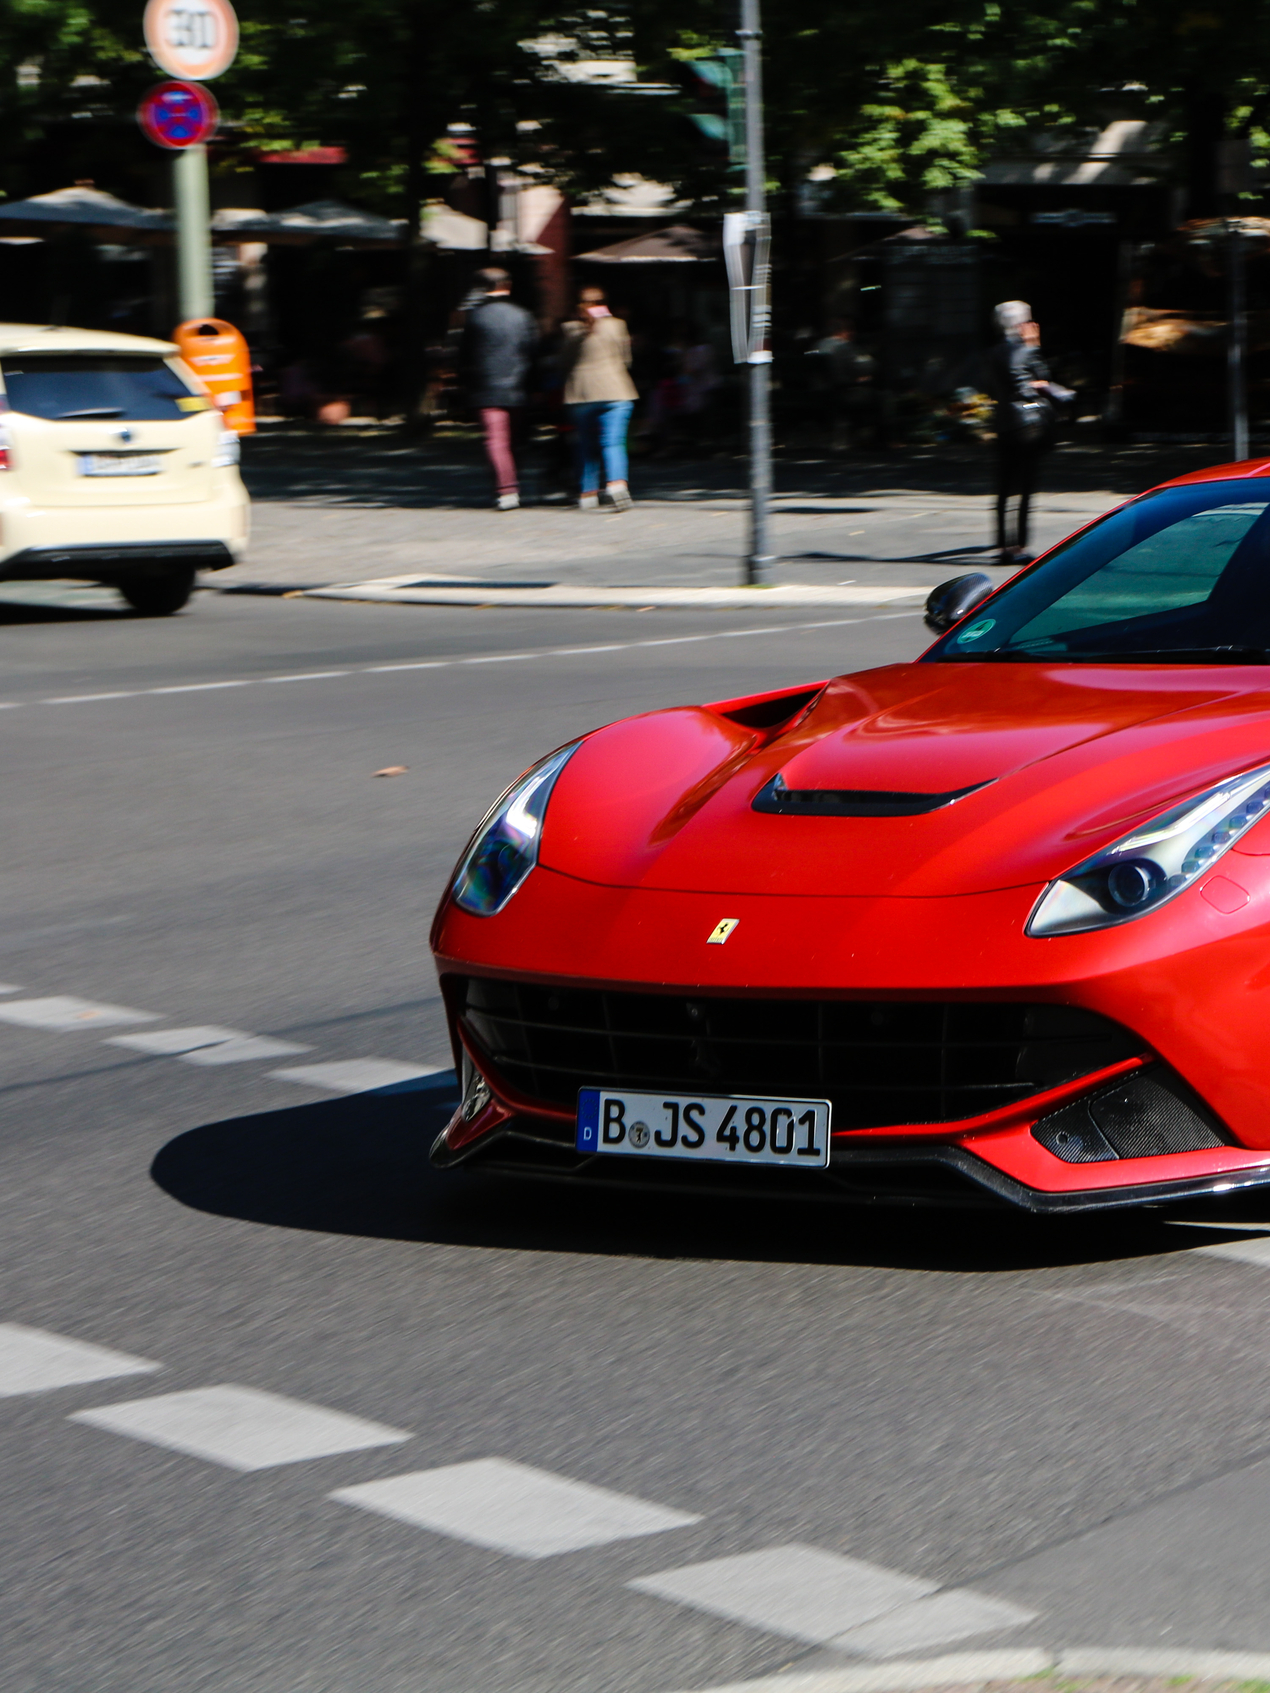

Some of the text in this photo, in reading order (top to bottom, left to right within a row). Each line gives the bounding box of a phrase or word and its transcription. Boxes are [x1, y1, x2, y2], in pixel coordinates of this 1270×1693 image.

[583, 1126, 593, 1141] D
[602, 1098, 822, 1157] B JS 4801
